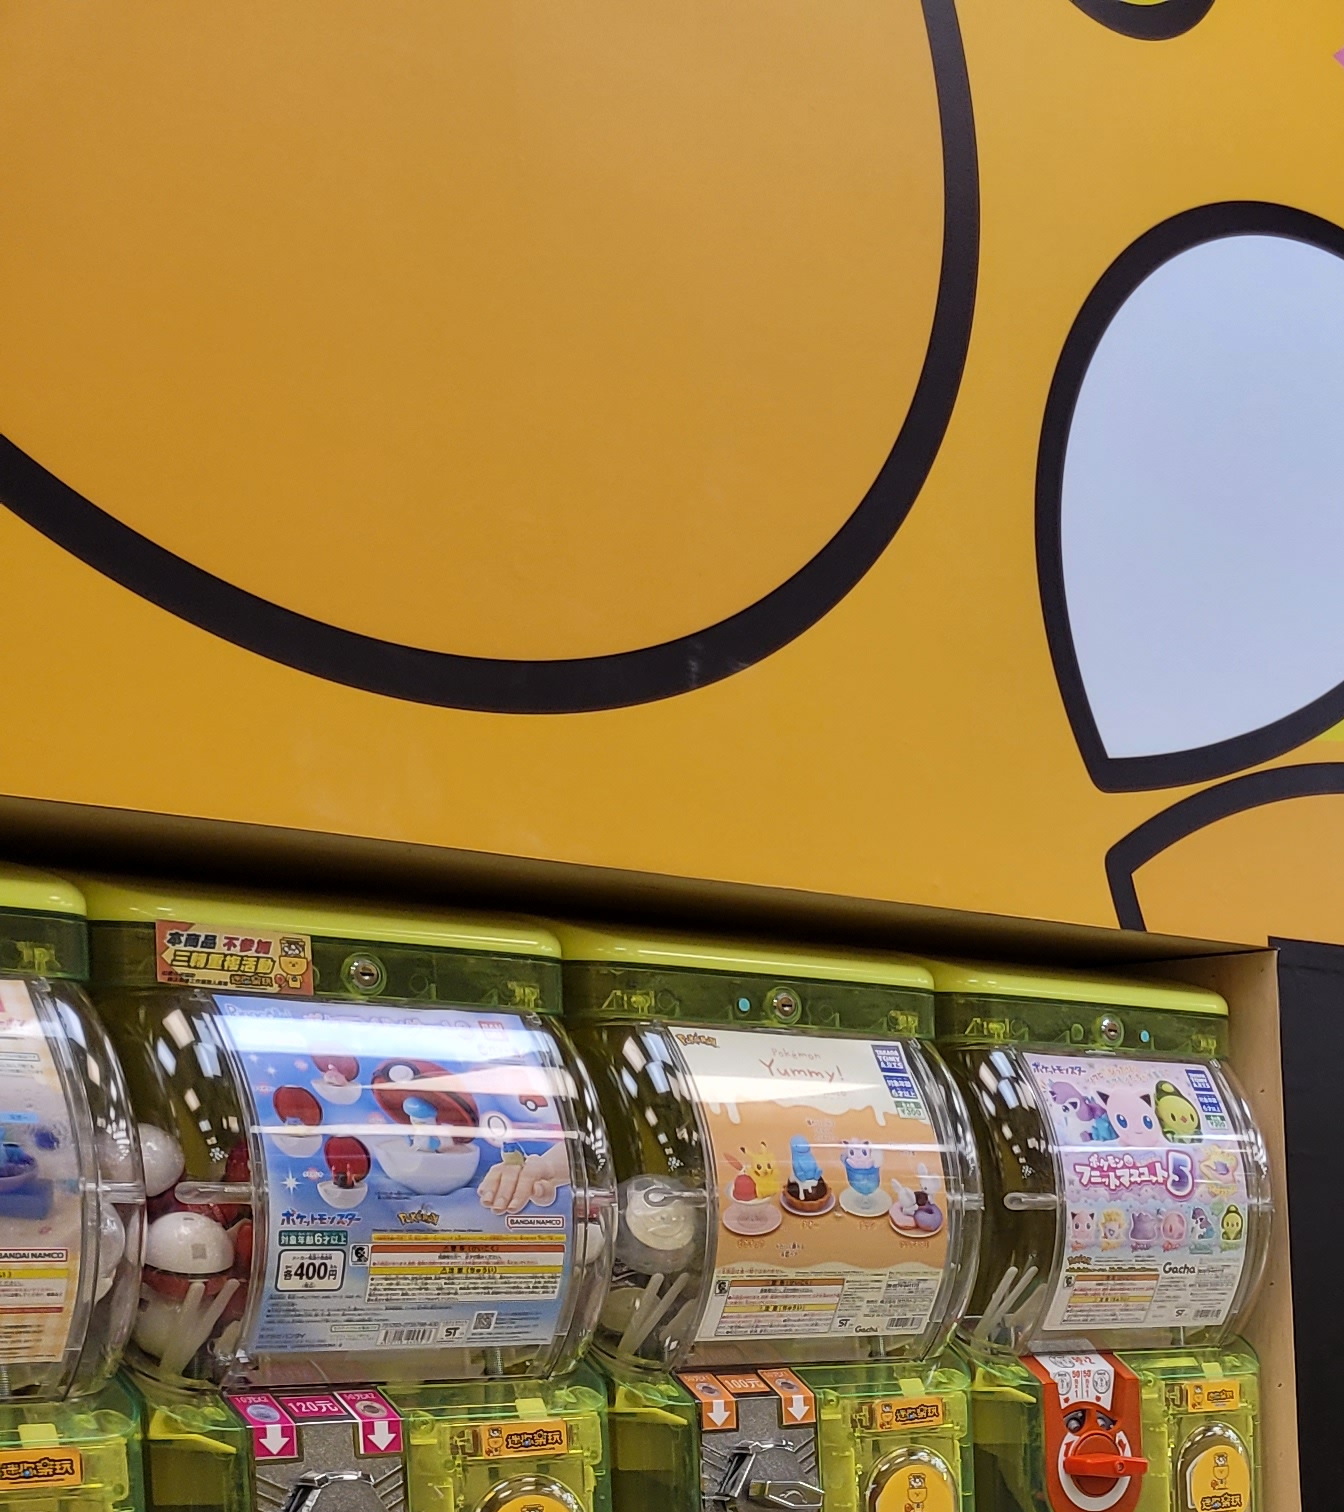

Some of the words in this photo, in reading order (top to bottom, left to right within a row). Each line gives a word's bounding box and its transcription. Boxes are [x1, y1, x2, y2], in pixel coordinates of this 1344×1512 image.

[166, 931, 217, 949] 本商品
[877, 1055, 901, 1064] TOMY
[880, 1061, 904, 1070] ARTS
[758, 1057, 844, 1084] Yummy!
[1088, 1153, 1126, 1170] ポケモン
[1167, 1150, 1194, 1197] 5
[281, 1208, 361, 1226] ポケットモンスター
[510, 1218, 535, 1226] BANDAI
[536, 1218, 561, 1226] NAMCO
[30, 1252, 64, 1260] NAMCO
[1162, 1261, 1196, 1275] Gacha
[724, 1378, 764, 1390] 100元
[288, 1400, 340, 1414] 120元
